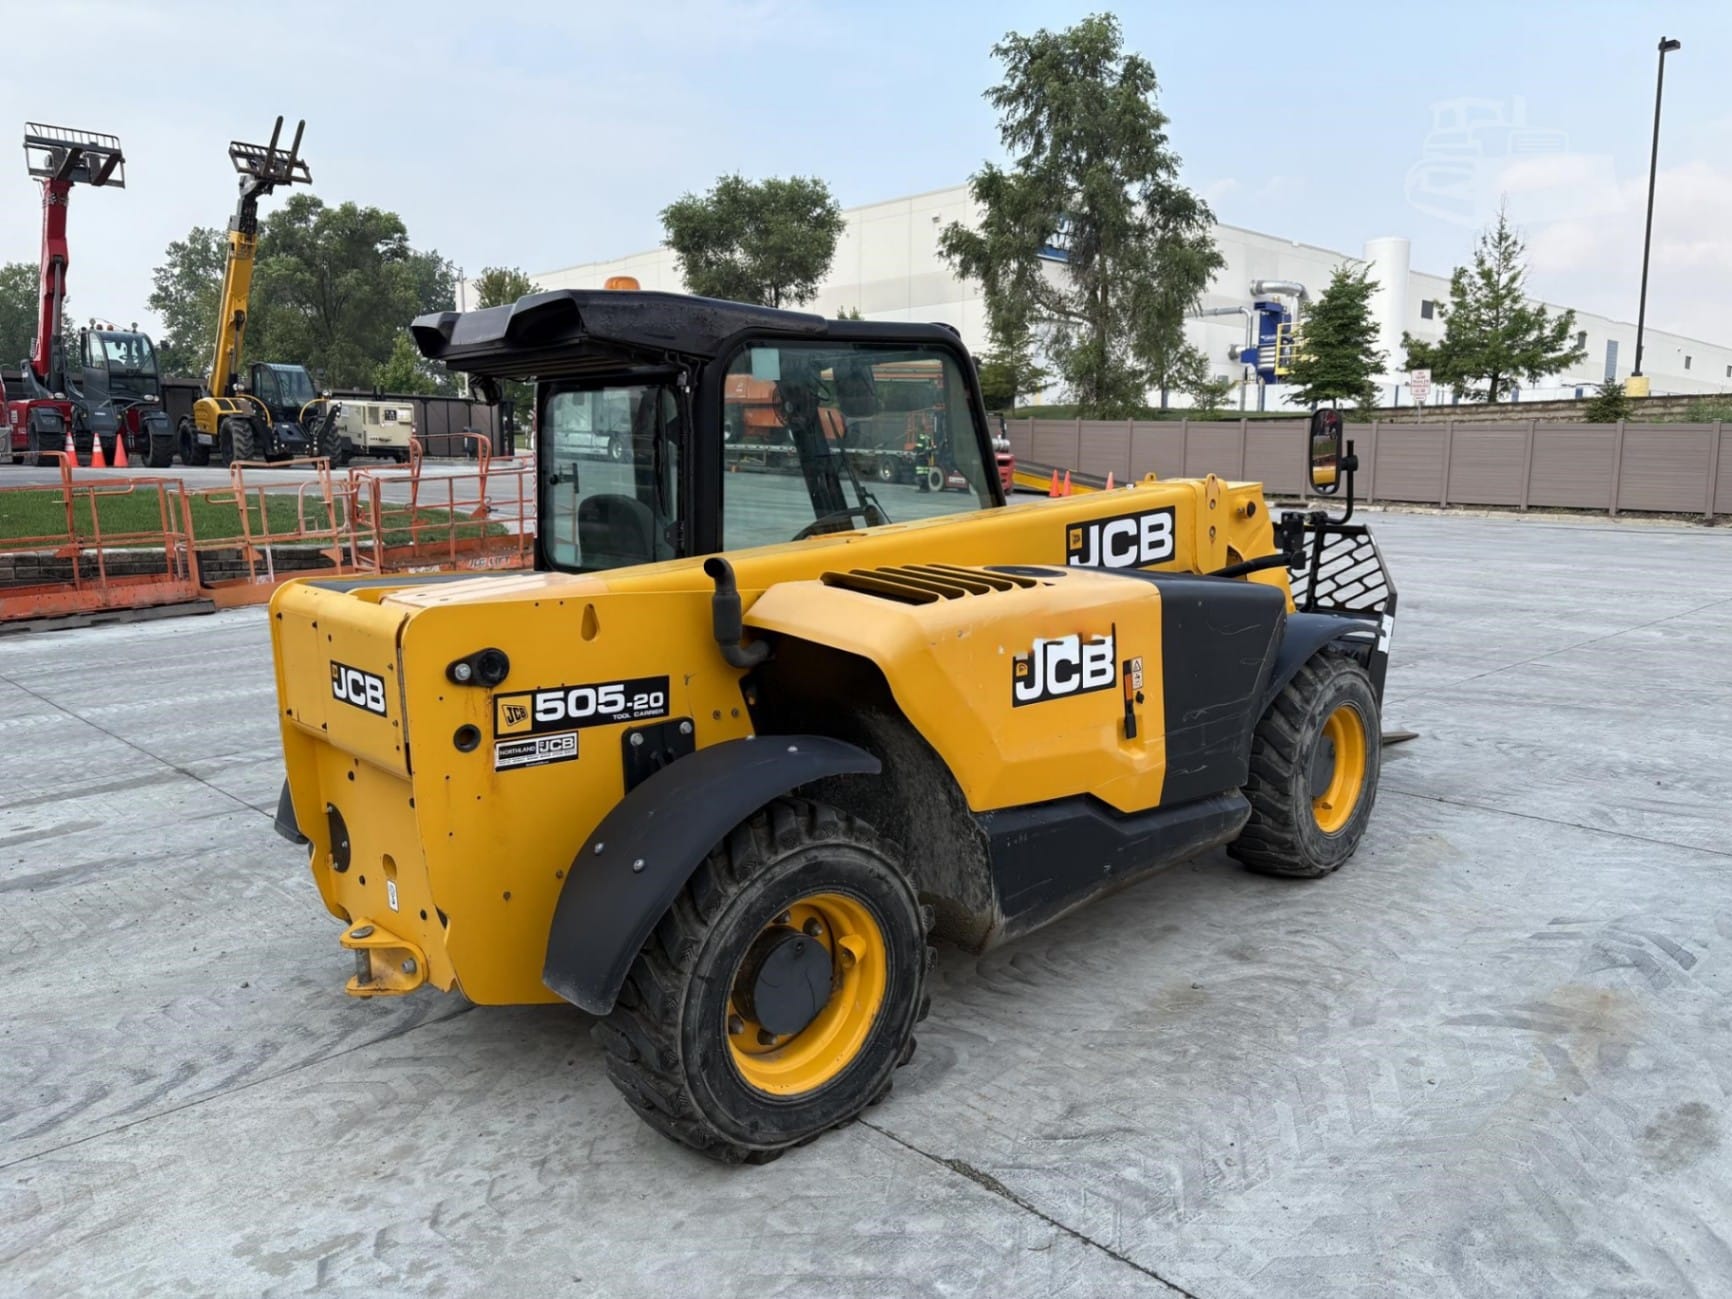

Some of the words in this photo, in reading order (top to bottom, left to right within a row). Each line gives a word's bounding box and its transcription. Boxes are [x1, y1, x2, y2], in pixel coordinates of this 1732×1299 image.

[1069, 512, 1173, 568] JCB
[1015, 634, 1115, 700] JCB
[333, 666, 385, 713] JCB
[535, 684, 664, 722] 505-20
[506, 706, 527, 723] JCB
[633, 708, 664, 718] CARRIER
[499, 745, 536, 756] NORTHLAND
[539, 737, 574, 752] JCB
